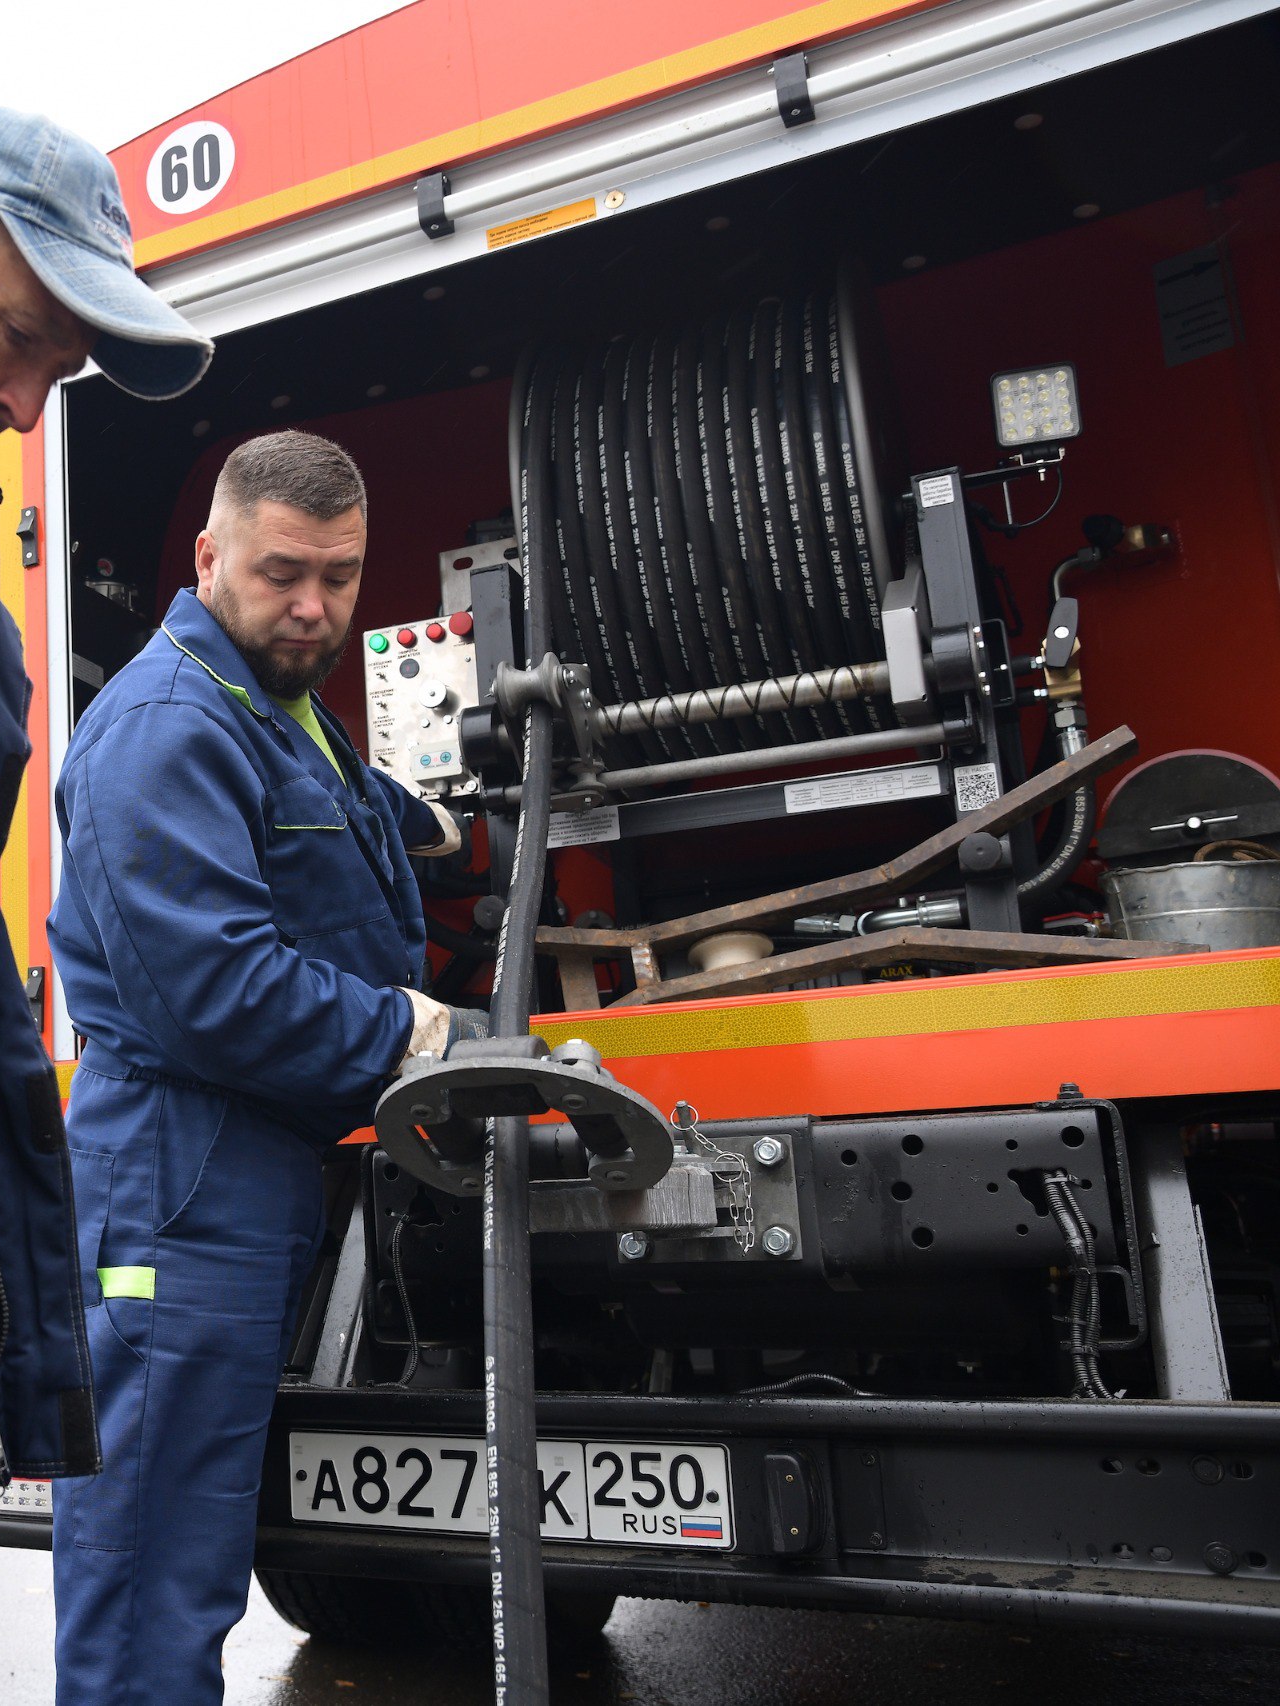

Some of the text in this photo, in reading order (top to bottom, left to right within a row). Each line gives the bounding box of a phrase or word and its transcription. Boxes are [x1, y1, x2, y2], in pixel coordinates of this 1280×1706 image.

[160, 133, 221, 203] 60
[725, 427, 731, 440] EN
[752, 416, 761, 448] SVAROG
[780, 431, 790, 464] SVAROG
[701, 453, 708, 466] DN
[755, 454, 763, 466] EN
[814, 441, 825, 476] SVAROG
[702, 466, 709, 477] 25
[757, 467, 765, 482] 853
[843, 452, 855, 487] SVAROG
[576, 472, 582, 485] WP
[704, 477, 712, 491] WP
[785, 471, 793, 484] EN
[759, 486, 768, 503] 2SN
[787, 485, 796, 500] 853
[820, 482, 829, 495] EN
[628, 497, 635, 509] EN
[732, 490, 738, 502] DN
[849, 494, 858, 507] EN
[604, 502, 610, 514] DN
[734, 504, 740, 514] 25
[822, 496, 832, 512] 853
[790, 504, 799, 521] 2SN
[852, 509, 862, 524] 853
[605, 516, 612, 525] 25
[736, 515, 743, 529] WP
[764, 520, 772, 532] DN
[825, 515, 834, 533] 2SN
[607, 526, 614, 540] WP
[766, 534, 774, 544] 25
[855, 528, 865, 545] 2SN
[795, 538, 804, 551] DN
[557, 528, 566, 560] SVAROG
[563, 567, 569, 578] EN
[660, 546, 666, 558] EN
[769, 545, 777, 560] WP
[798, 553, 806, 563] 25
[831, 550, 840, 562] DN
[637, 560, 644, 573] DN
[688, 553, 698, 585] SVAROG
[772, 562, 780, 576] 165
[800, 564, 809, 578] WP
[833, 564, 843, 574] 25
[861, 562, 870, 574] DN
[640, 574, 646, 584] 25
[836, 575, 845, 589] WP
[863, 576, 873, 586] 25
[642, 585, 649, 599] WP
[804, 580, 812, 593] 165
[839, 591, 848, 604] 165
[866, 588, 876, 600] WP
[591, 586, 602, 617] SVAROG
[598, 624, 605, 635] EN
[869, 603, 879, 616] 165
[872, 617, 880, 629] bar
[732, 635, 739, 645] EN
[628, 641, 639, 669] SVAROG
[1075, 796, 1085, 812] 853
[1072, 814, 1084, 832] 2SN
[1060, 845, 1074, 858] DN
[1051, 858, 1064, 870] 25
[1039, 868, 1055, 882] WP
[880, 965, 913, 978] ARAX
[485, 1116, 495, 1132] SN
[485, 1150, 494, 1168] DN
[484, 1169, 493, 1184] 25
[484, 1185, 493, 1204] WP
[484, 1206, 493, 1227] 165
[484, 1228, 493, 1249] bar
[486, 1372, 498, 1498] SVAROG EN 853
[592, 1450, 704, 1511] 250
[489, 1506, 499, 1537] 2SN
[623, 1514, 677, 1536] RUS
[492, 1572, 502, 1595] DN
[493, 1600, 503, 1618] 25
[494, 1622, 504, 1649] WP
[495, 1654, 506, 1682] 165
[496, 1687, 506, 1706] ba
